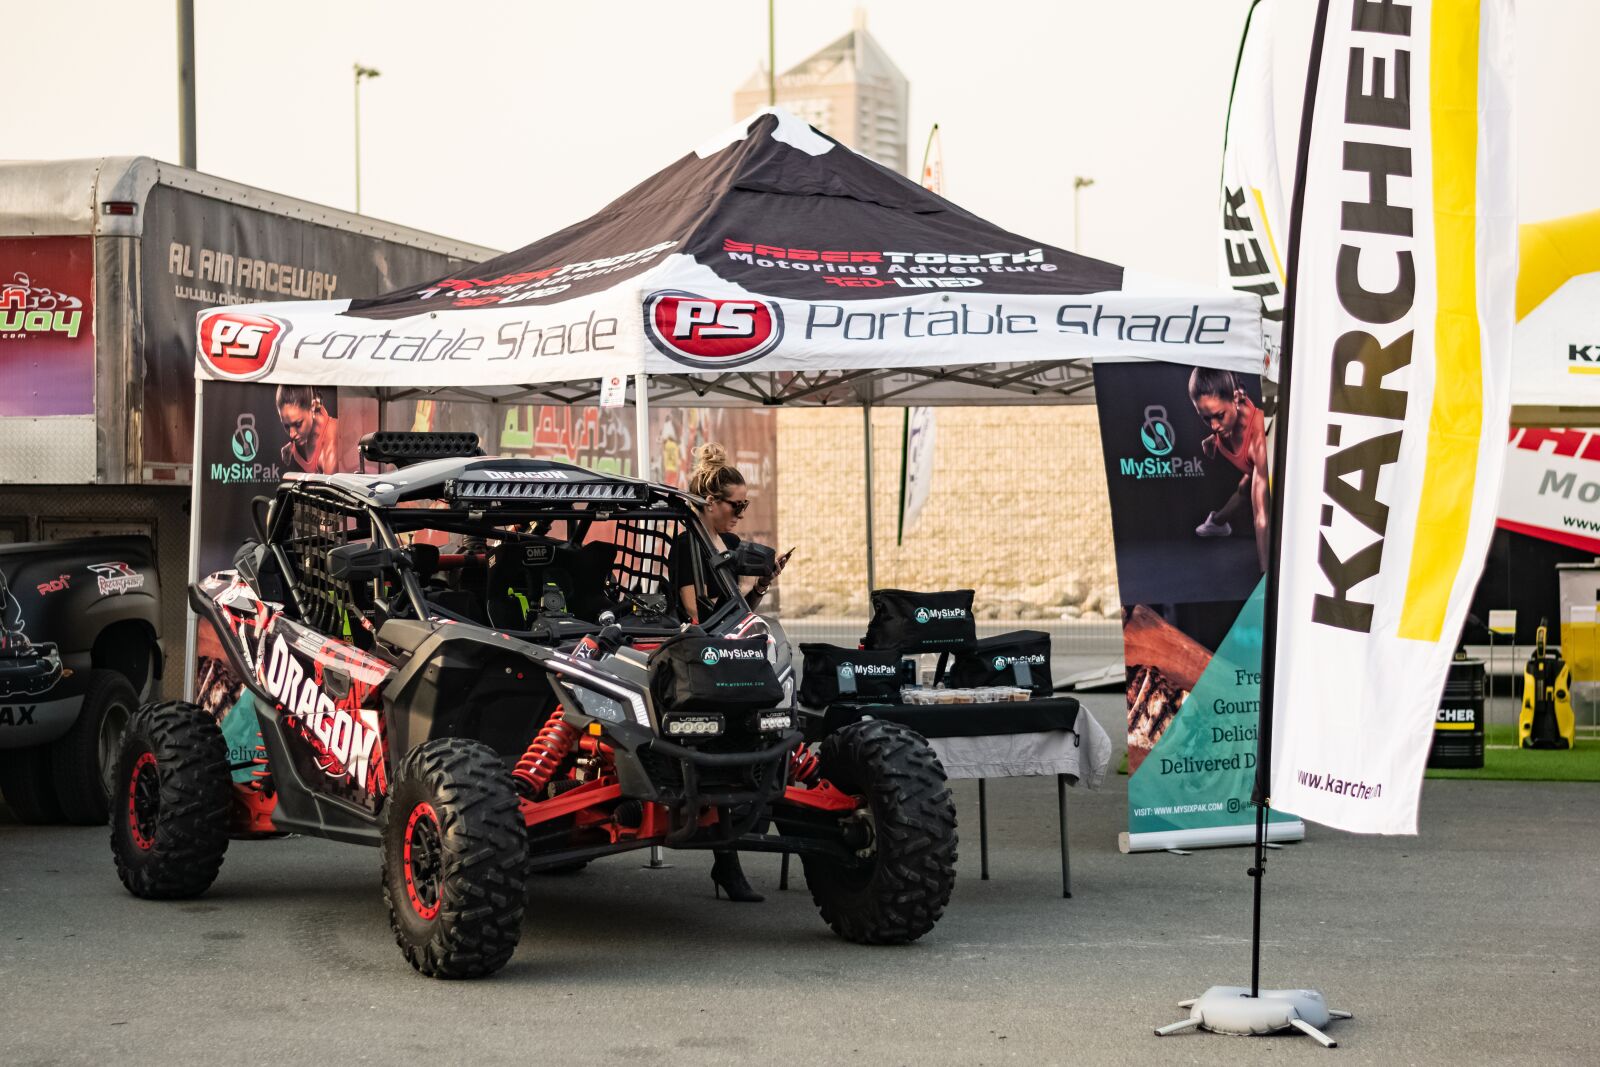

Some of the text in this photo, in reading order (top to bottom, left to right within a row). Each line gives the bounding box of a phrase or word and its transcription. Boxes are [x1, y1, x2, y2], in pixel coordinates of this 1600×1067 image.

[168, 242, 338, 300] AL AIN RACEWAY
[728, 252, 1058, 275] Motoring Adventure
[673, 301, 757, 340] PS
[805, 303, 1232, 345] Portable Shade
[211, 319, 274, 358] PS
[488, 310, 618, 361] Shade
[211, 463, 280, 484] MySixPak
[483, 470, 569, 479] DRAGON
[1120, 456, 1204, 479] MySixPak
[526, 548, 547, 558] OMP
[929, 608, 966, 619] MySixPa
[854, 665, 896, 675] MySixPak
[267, 633, 378, 788] DRAGON
[1161, 754, 1240, 775] Delivered
[1134, 802, 1223, 817] VISIT: WWW.MYSIXPAK.COM
